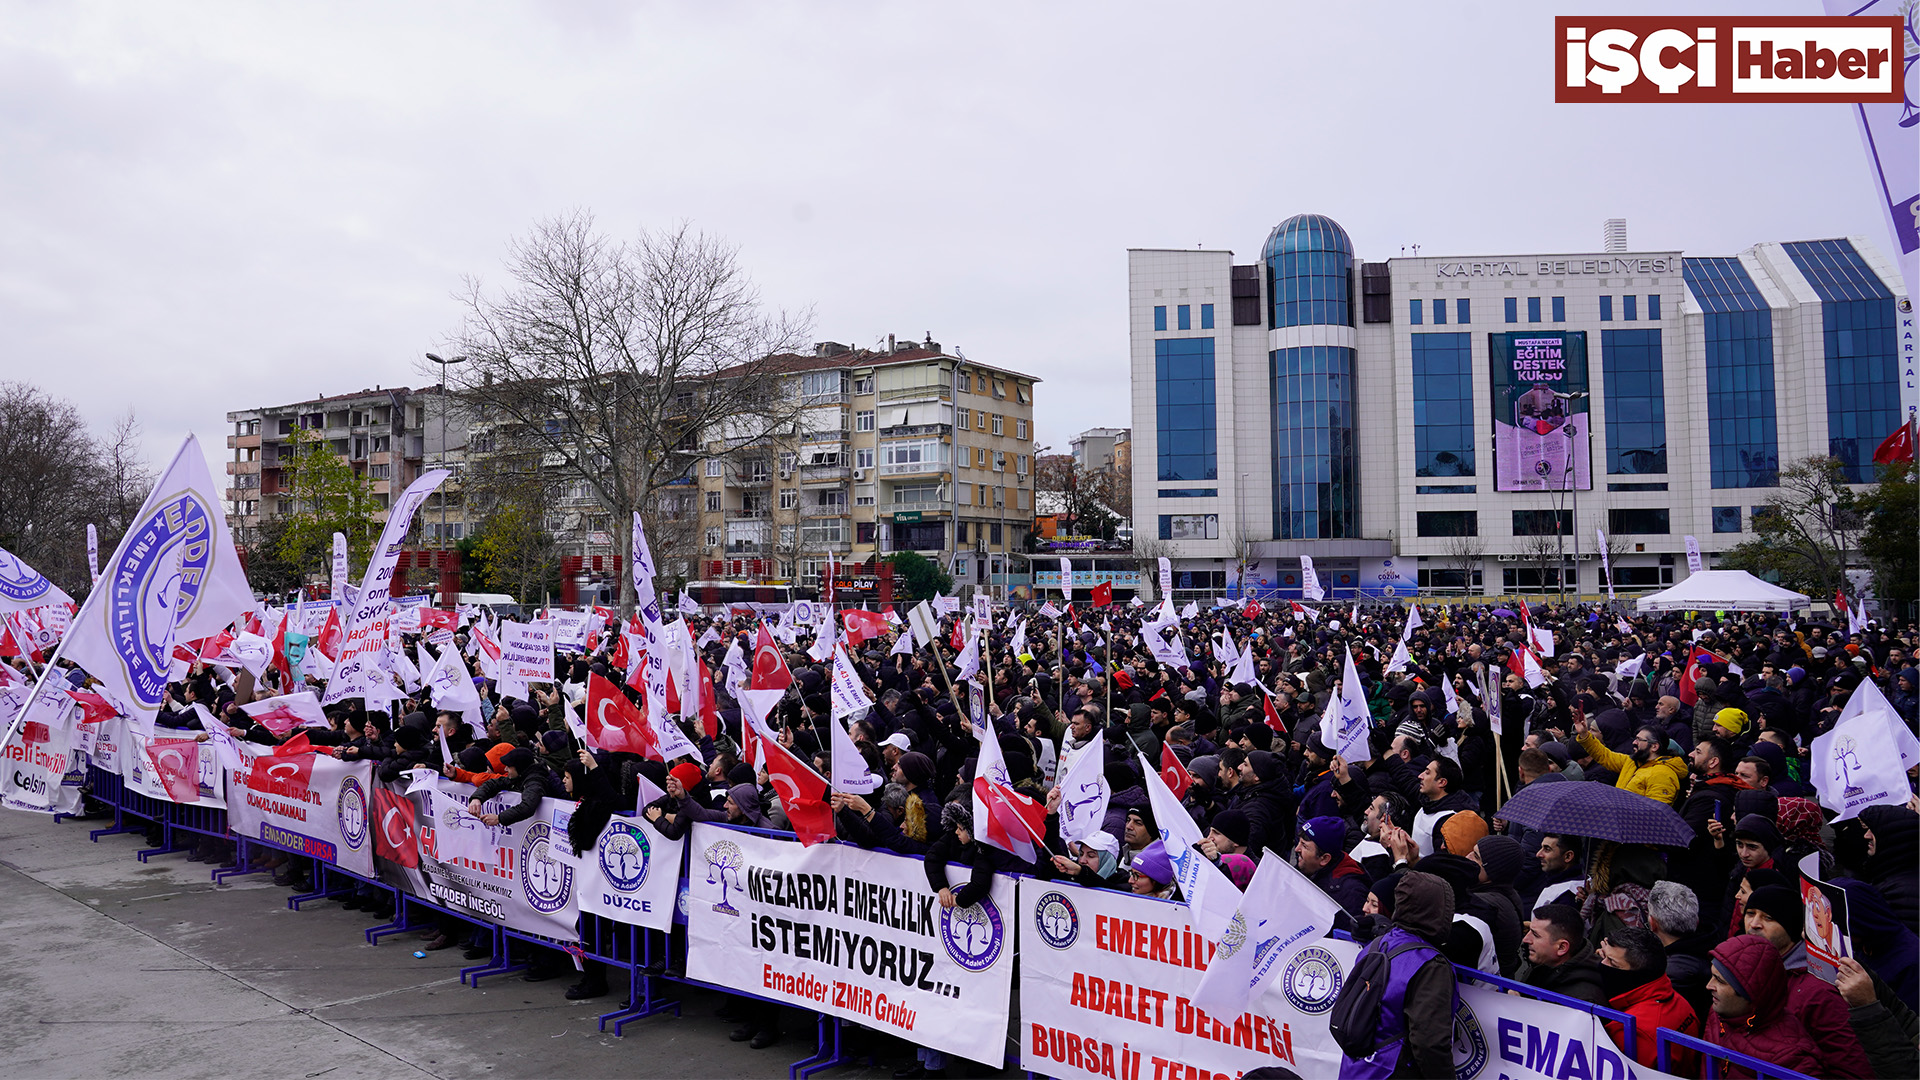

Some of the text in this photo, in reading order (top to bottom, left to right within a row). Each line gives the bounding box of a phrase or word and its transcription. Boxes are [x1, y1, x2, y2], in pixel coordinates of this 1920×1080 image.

[1436, 256, 1674, 277] KARTAL BELEDİYESİ
[1516, 346, 1562, 360] EĞİTİM
[1903, 320, 1914, 388] KARTAL
[1514, 360, 1566, 370] DESTEK
[1518, 370, 1562, 381] KURSU
[22, 580, 46, 596] ADALET
[117, 530, 166, 698] EMEKLİLİKTE ADALE
[840, 670, 848, 679] 43
[845, 678, 854, 690] YAŞ
[310, 790, 322, 806] YIL
[630, 828, 650, 857] DÜZCE
[430, 882, 505, 920] EMADER İNEGÖL
[482, 882, 513, 898] HAKKIMIZ
[538, 898, 563, 910] ADALET
[603, 893, 652, 913] DÜZCE
[748, 866, 839, 914] MEZARDA
[844, 877, 936, 938] EMEKLİLİK
[1062, 898, 1077, 923] BURSA
[942, 925, 1000, 967] Emeklilikte Adalet Derneği
[1291, 949, 1340, 975] EMADDER
[763, 963, 917, 1032] Emadder İZMİR Grubu
[1070, 972, 1168, 1028] ADALET
[1305, 1002, 1328, 1011] ADALET
[1032, 1022, 1116, 1080] BURSA
